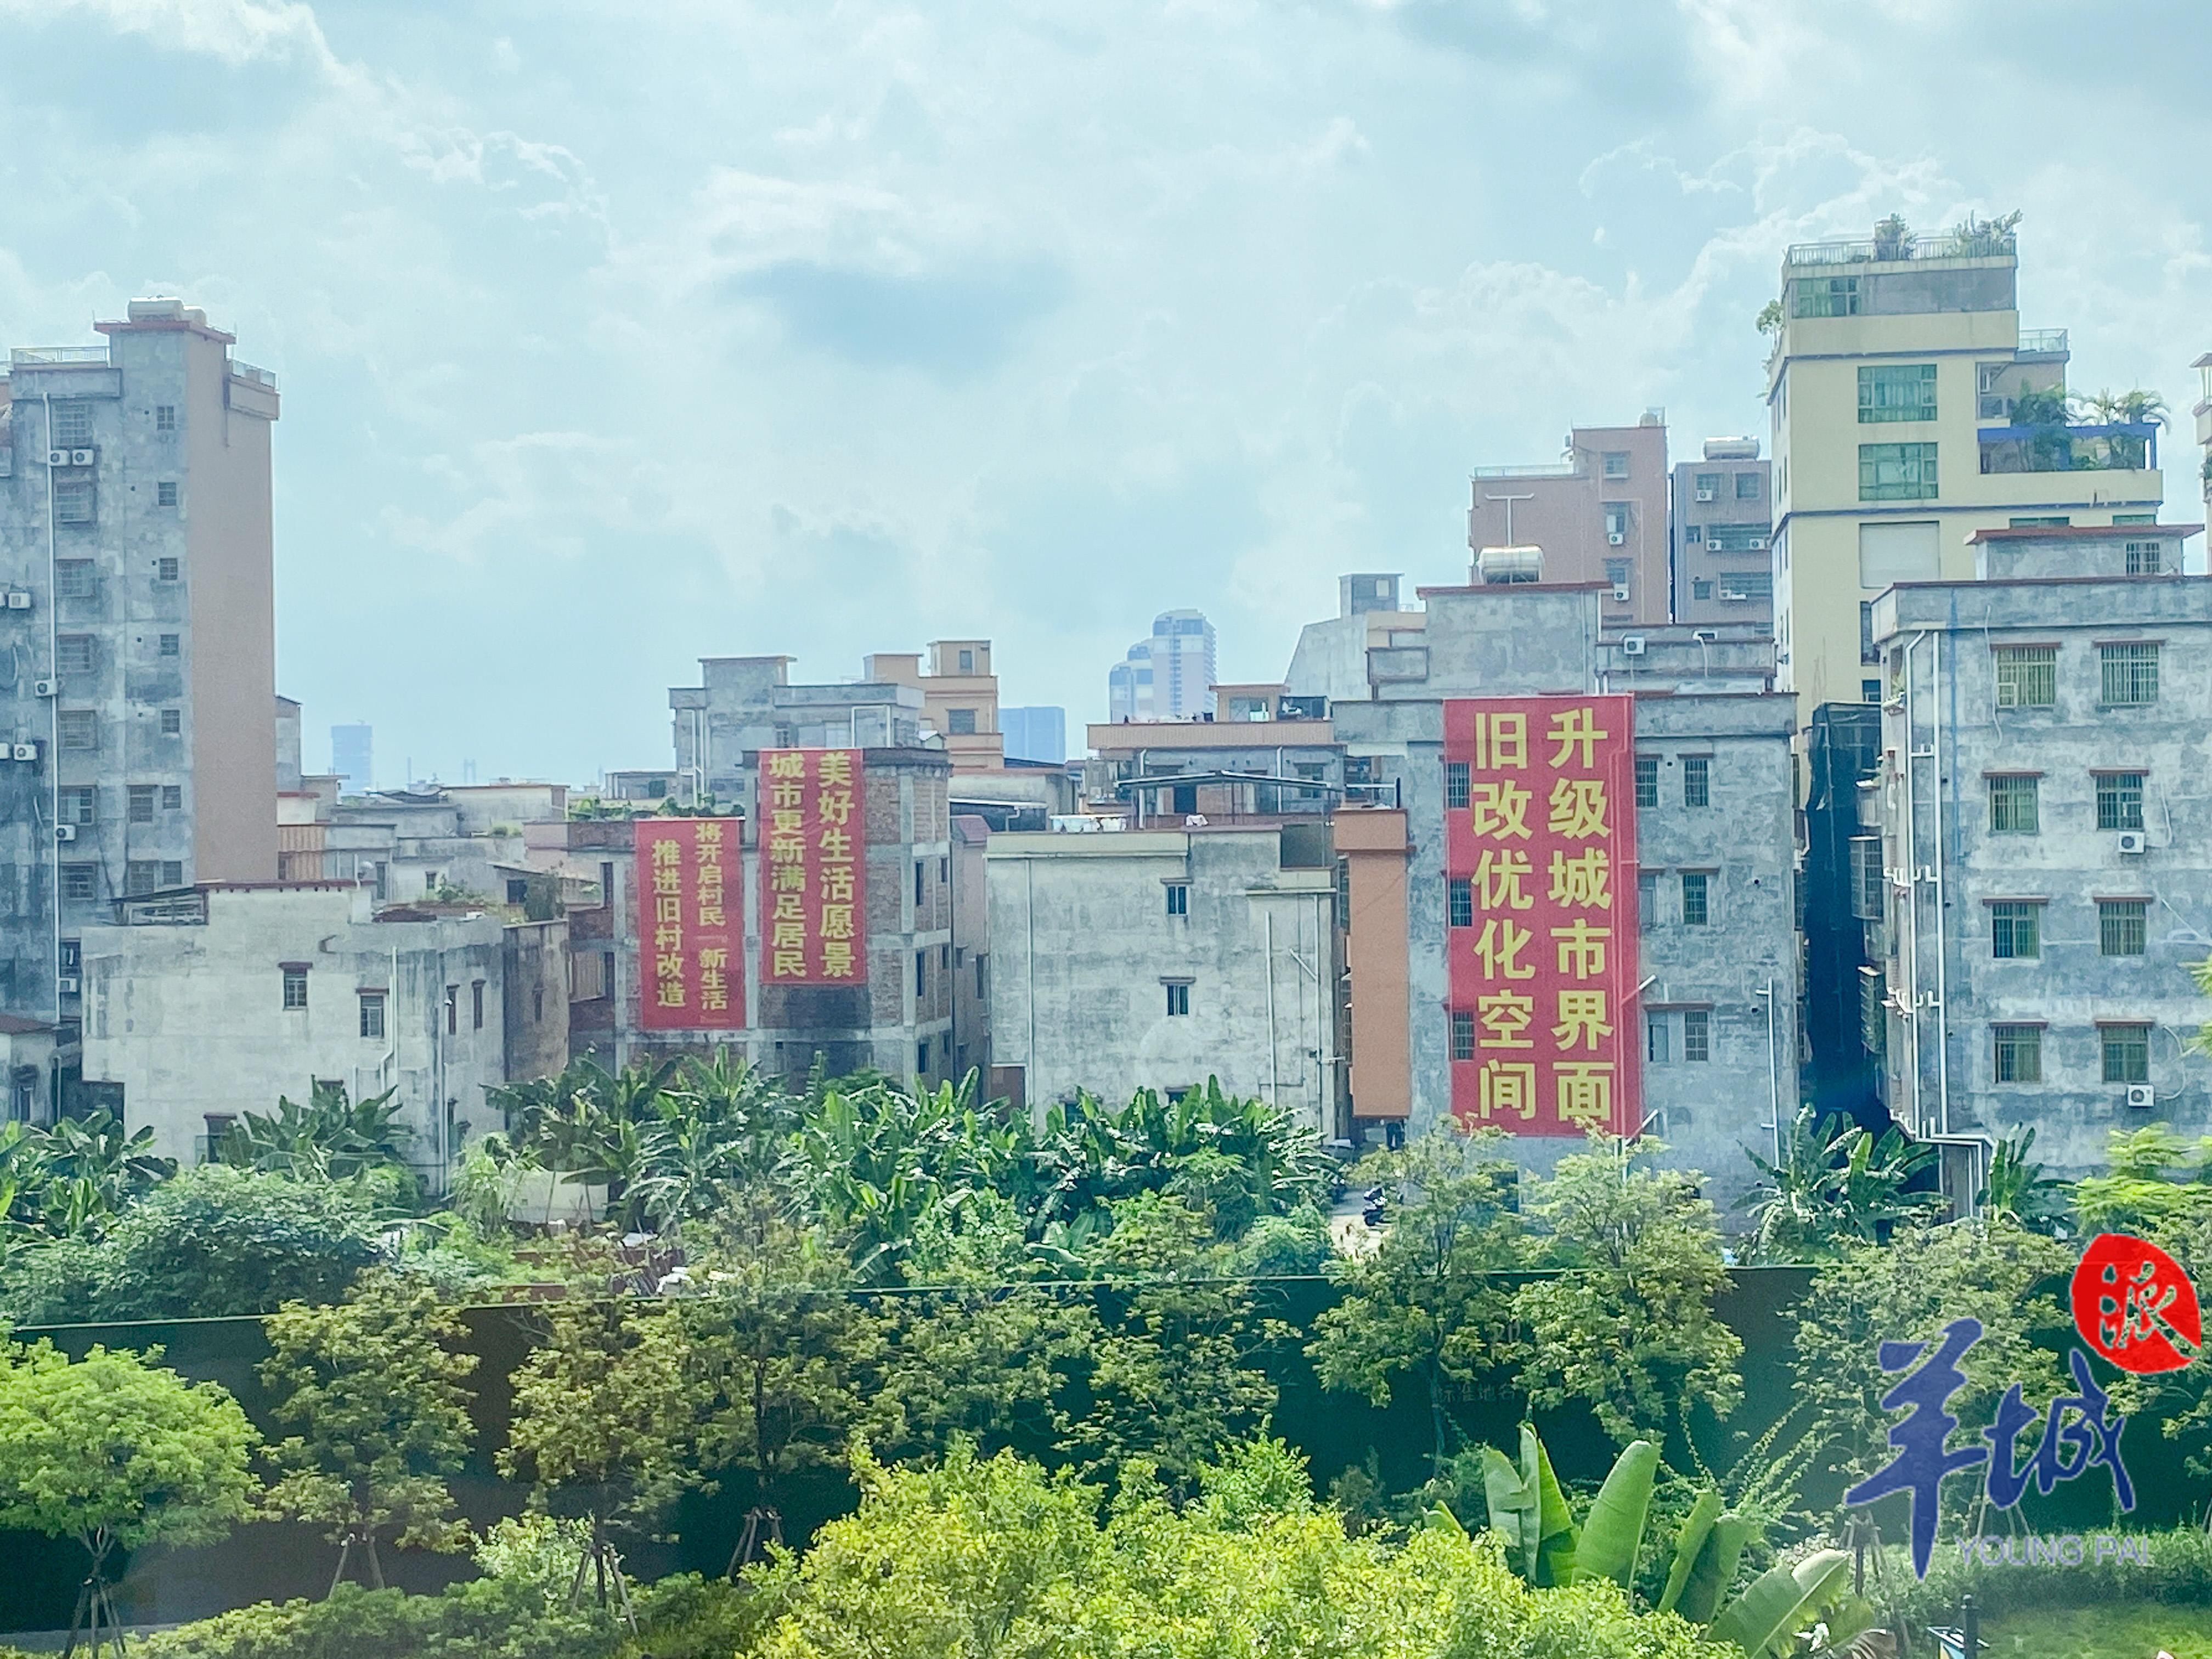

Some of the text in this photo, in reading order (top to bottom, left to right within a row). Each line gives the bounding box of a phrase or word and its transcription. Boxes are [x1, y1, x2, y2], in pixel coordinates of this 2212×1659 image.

[651, 839, 686, 1007] 推进旧村改造
[769, 752, 808, 978] 城市更新满足居民
[817, 751, 856, 978] 美好生活愿景
[1471, 711, 1537, 1120] 旧改优化空间
[1547, 707, 1614, 1122] 升级城市界面
